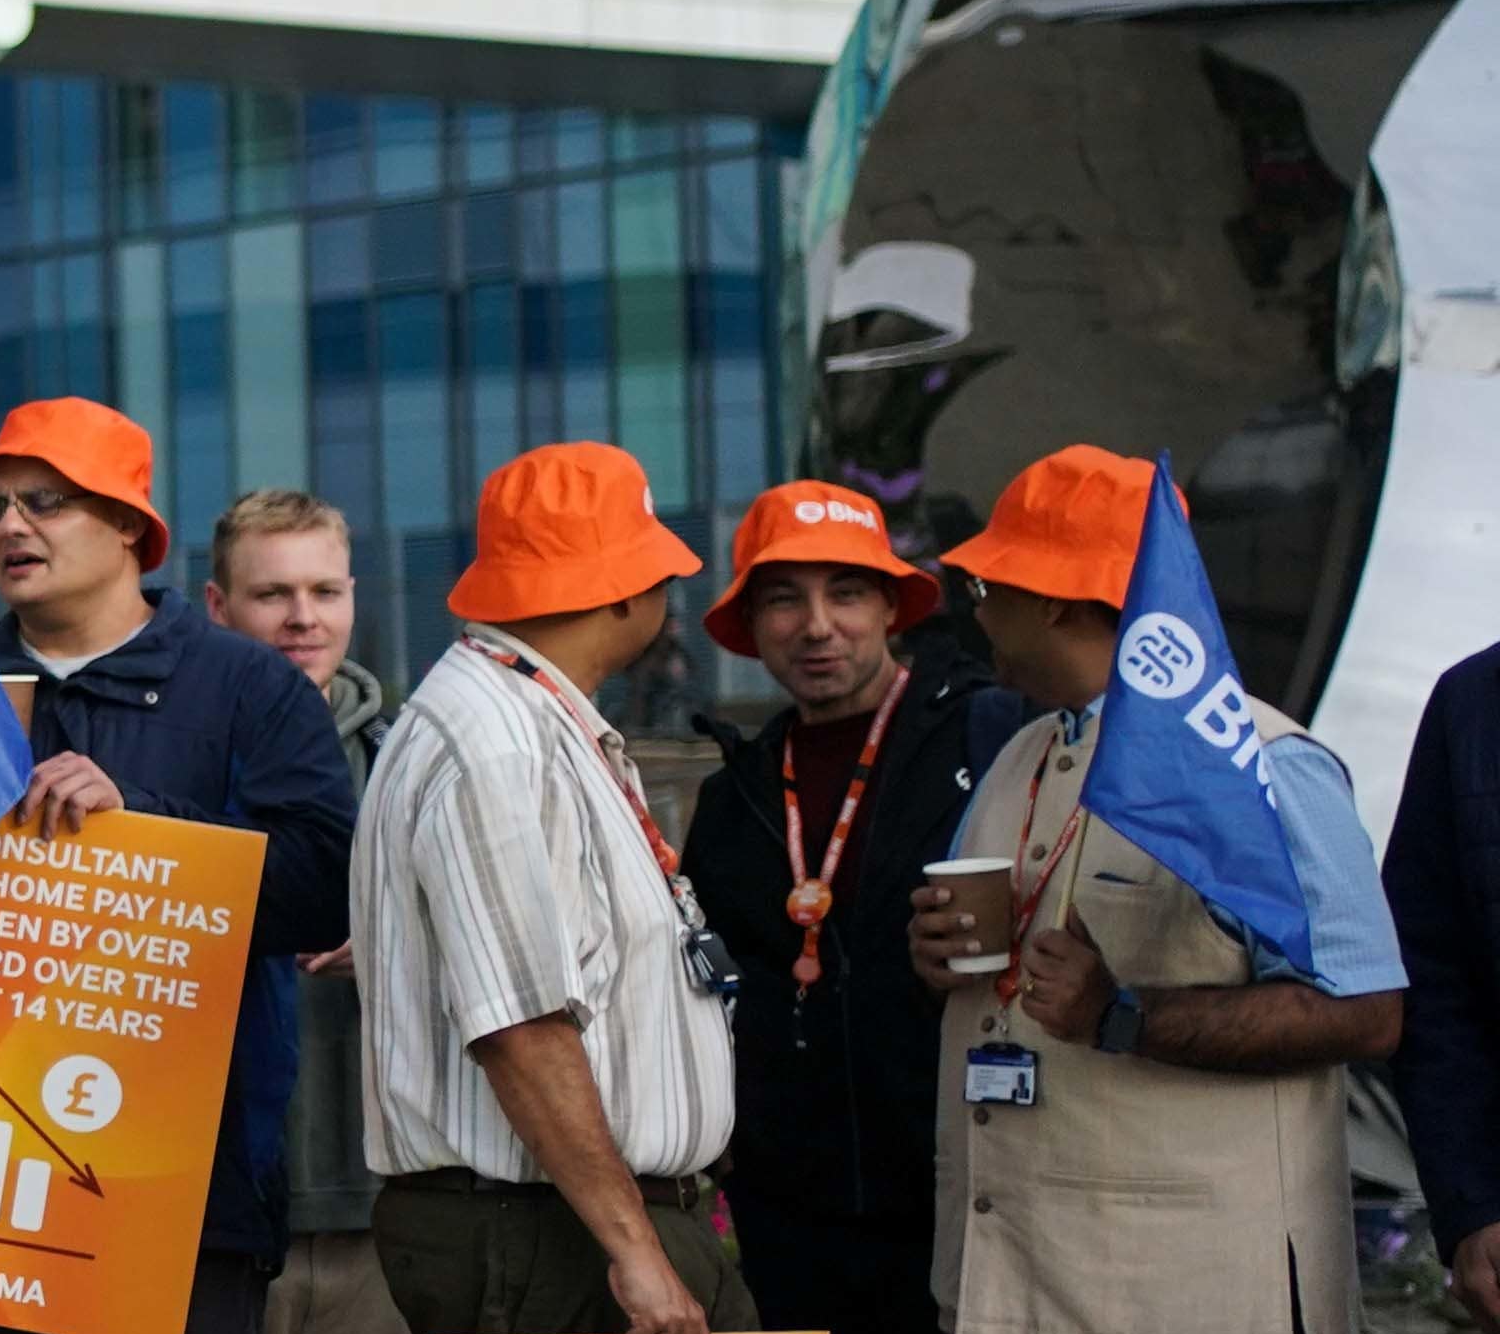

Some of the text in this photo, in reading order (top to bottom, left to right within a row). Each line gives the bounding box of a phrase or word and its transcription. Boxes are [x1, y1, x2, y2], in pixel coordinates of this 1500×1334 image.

[92, 887, 231, 935] PAY HAS
[48, 919, 191, 968] BY OVER
[33, 956, 126, 996] OVER
[133, 972, 200, 1009] THE
[11, 991, 47, 1021] 14
[54, 998, 163, 1041] YEARS
